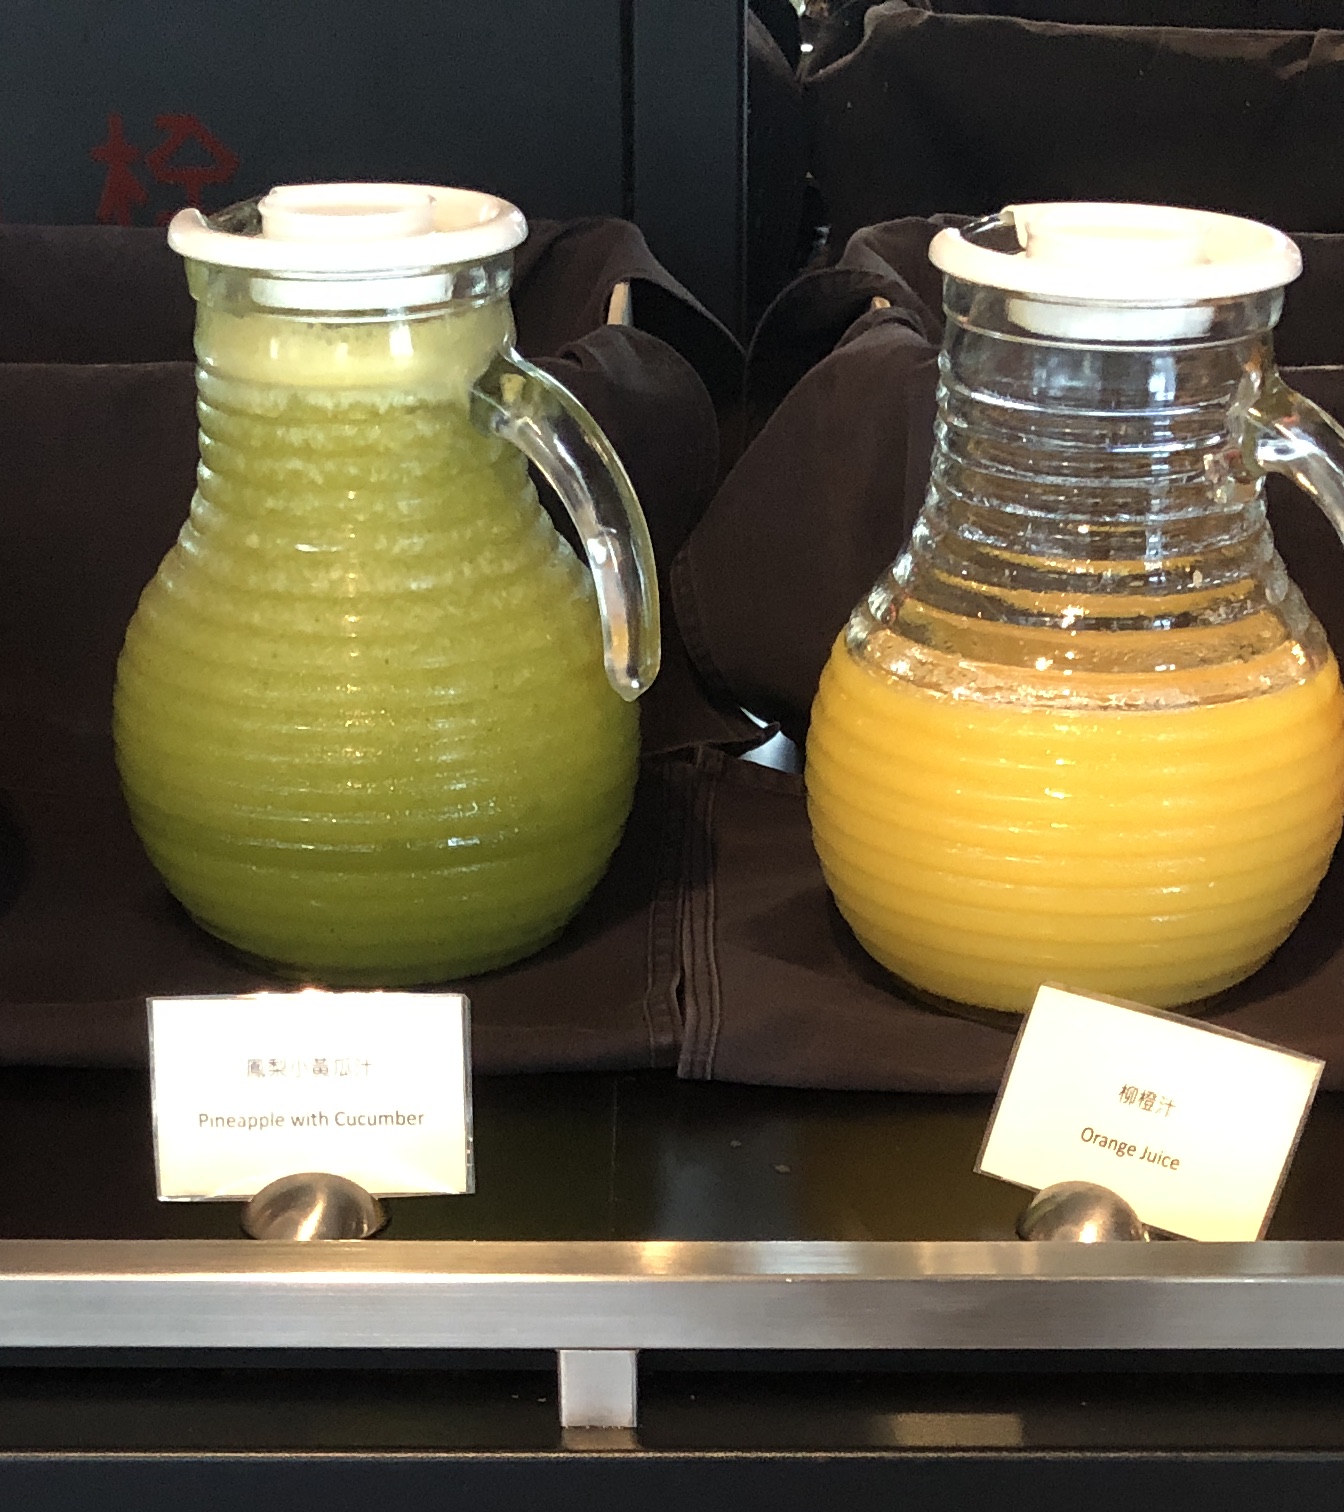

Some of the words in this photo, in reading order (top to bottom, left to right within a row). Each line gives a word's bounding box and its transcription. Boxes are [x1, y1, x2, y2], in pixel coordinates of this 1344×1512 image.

[1118, 1083, 1176, 1117] 柳橙汁
[198, 1111, 285, 1131] Pineapple
[290, 1110, 329, 1127] with
[334, 1109, 425, 1127] Cucumber
[1080, 1126, 1137, 1158] Orange
[1139, 1145, 1181, 1171] Juice
